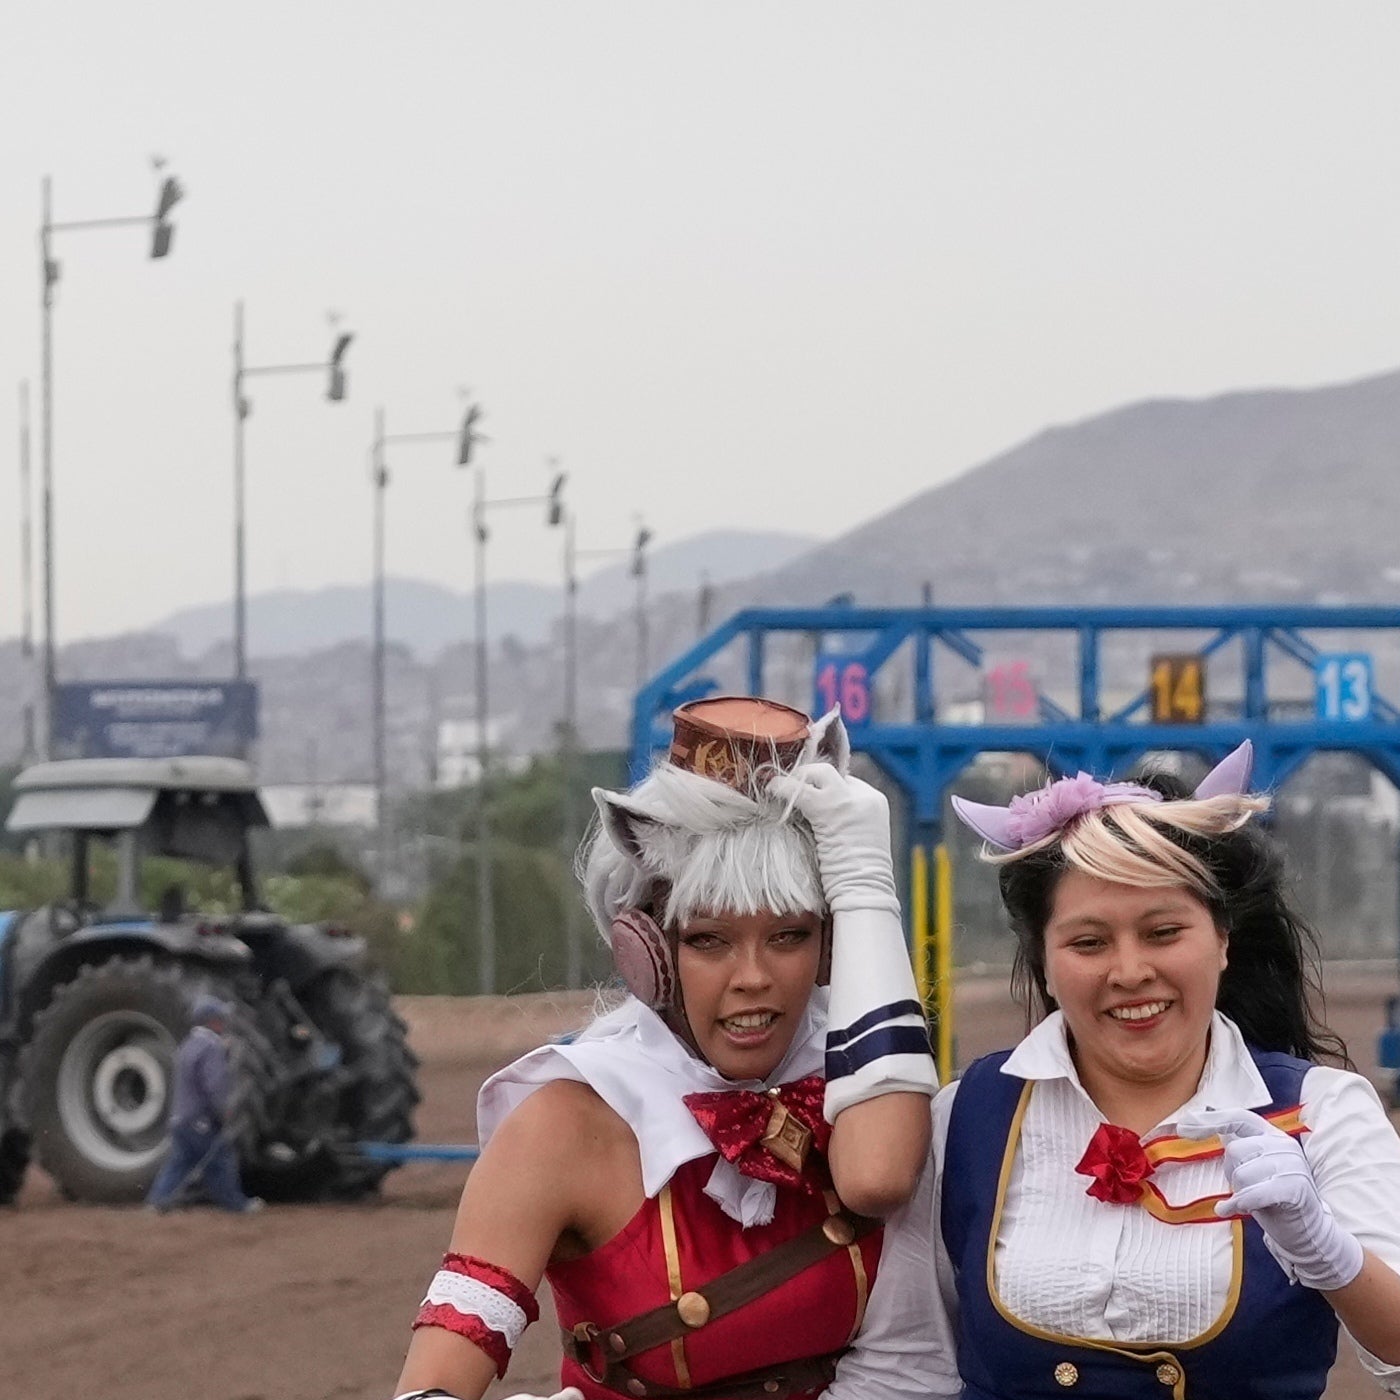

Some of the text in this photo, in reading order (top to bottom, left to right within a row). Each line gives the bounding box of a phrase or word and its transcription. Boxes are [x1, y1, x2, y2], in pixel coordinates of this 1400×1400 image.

[817, 662, 869, 721] 16
[988, 661, 1037, 716] 15
[1153, 660, 1201, 721] 14
[1319, 660, 1370, 721] 13
